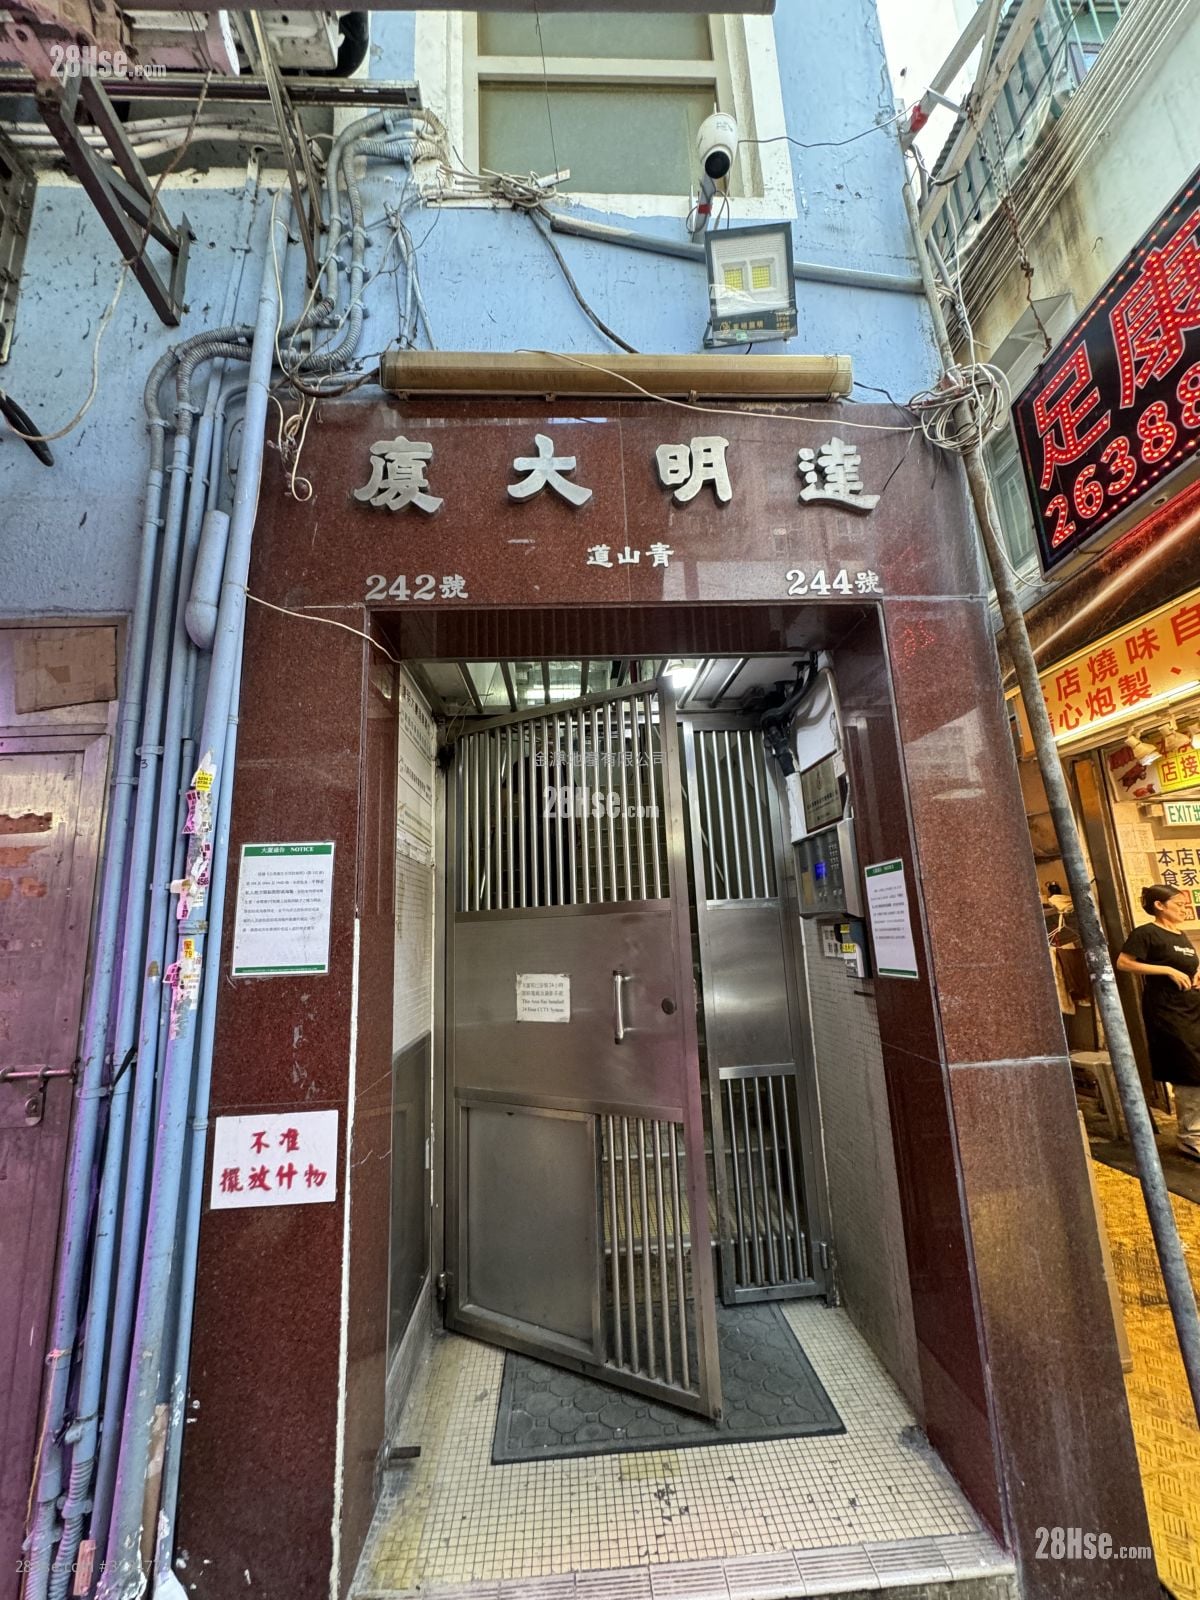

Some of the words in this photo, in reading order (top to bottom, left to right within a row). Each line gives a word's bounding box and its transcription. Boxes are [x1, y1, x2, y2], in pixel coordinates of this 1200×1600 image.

[365, 573, 469, 600] 242號
[785, 569, 883, 597] 244號
[1041, 603, 1200, 703] 店燒味自
[1168, 805, 1191, 822] EXIT
[1156, 848, 1200, 866] 本店
[1161, 868, 1200, 886] 食家
